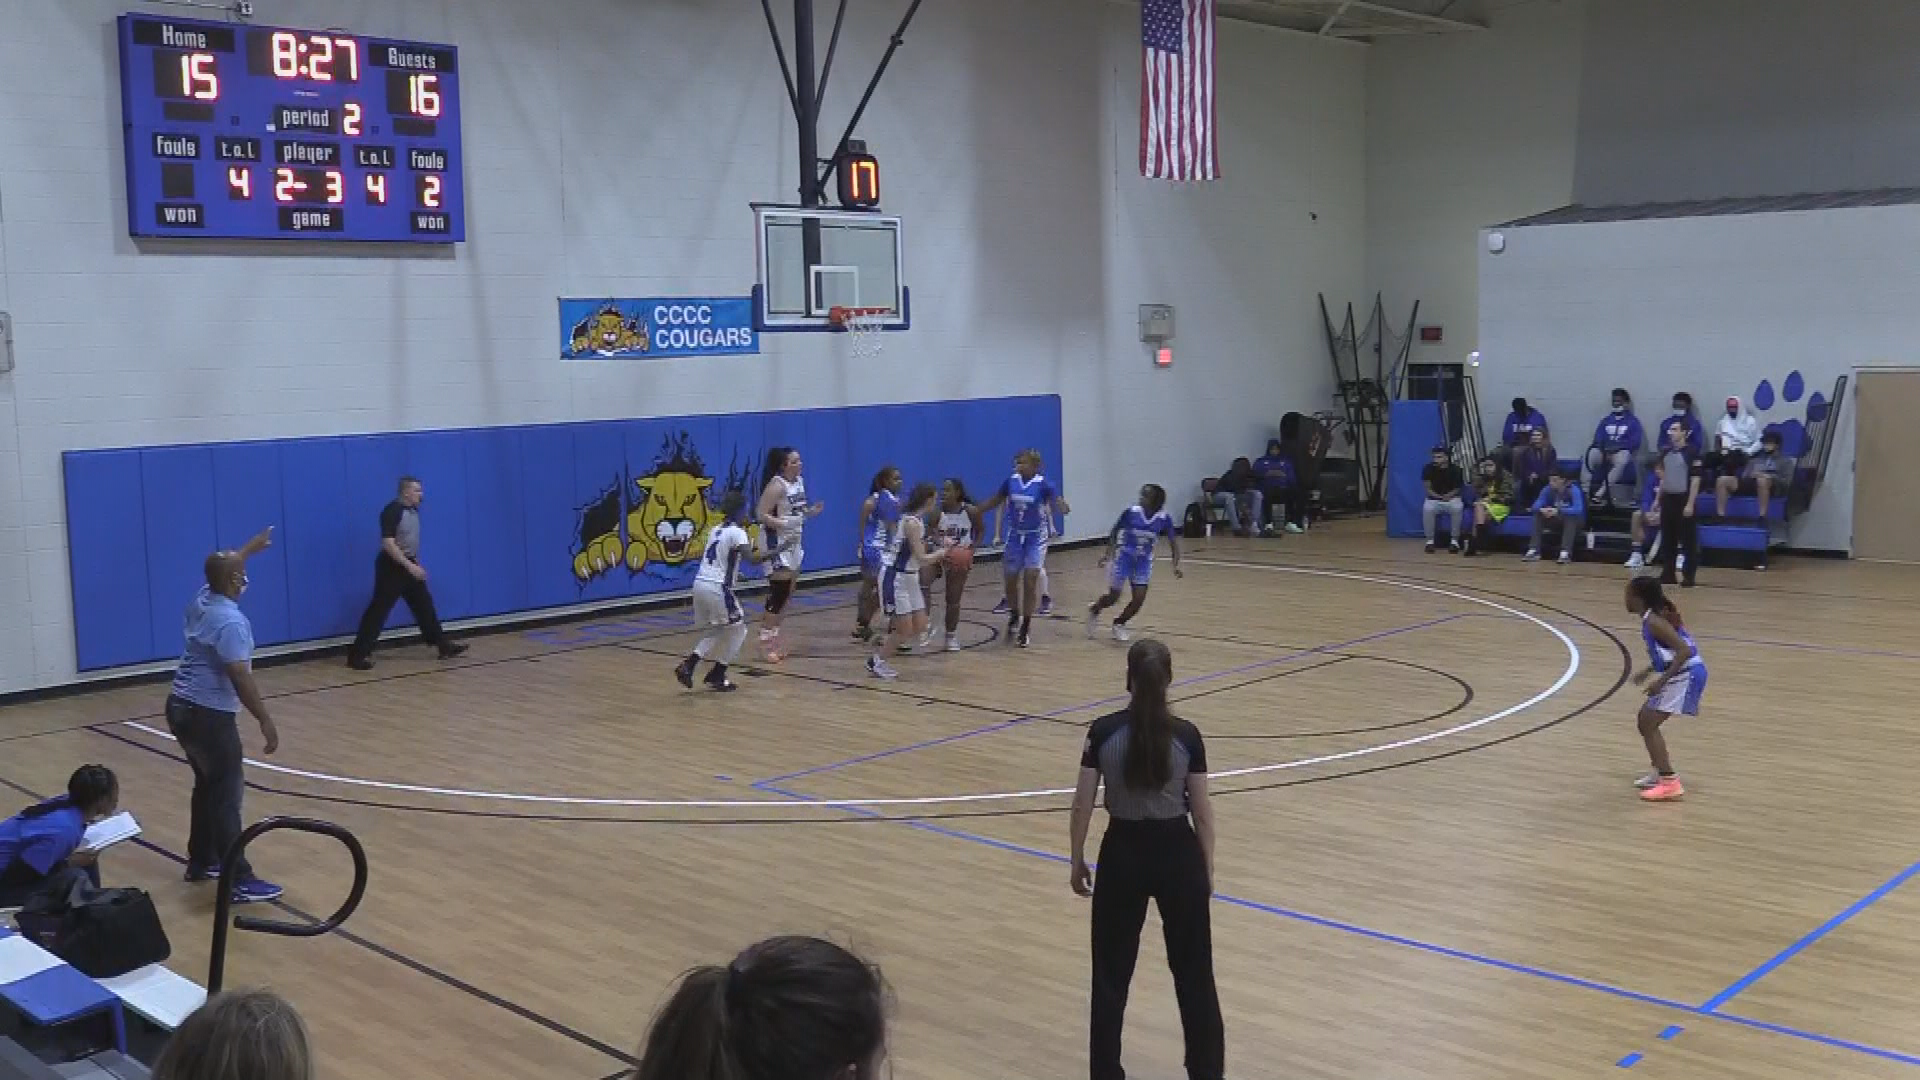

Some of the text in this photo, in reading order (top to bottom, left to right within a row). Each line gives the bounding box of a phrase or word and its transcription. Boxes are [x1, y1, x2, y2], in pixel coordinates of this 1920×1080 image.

[162, 25, 207, 49] Home
[272, 32, 358, 82] 8:27
[388, 47, 437, 70] Guests
[181, 53, 219, 100] 15
[409, 74, 440, 117] 16
[282, 108, 330, 130] period
[343, 103, 362, 136] 2
[156, 135, 196, 158] Fouls
[283, 143, 333, 165] player
[411, 150, 444, 170] Fouls
[229, 167, 249, 198] 4
[366, 175, 385, 203] 4
[423, 176, 440, 207] 2
[851, 161, 877, 199] 17
[164, 206, 197, 224] won
[292, 209, 331, 229] game
[417, 216, 445, 230] won
[654, 305, 712, 325] CCCC
[655, 327, 753, 349] COUGARS
